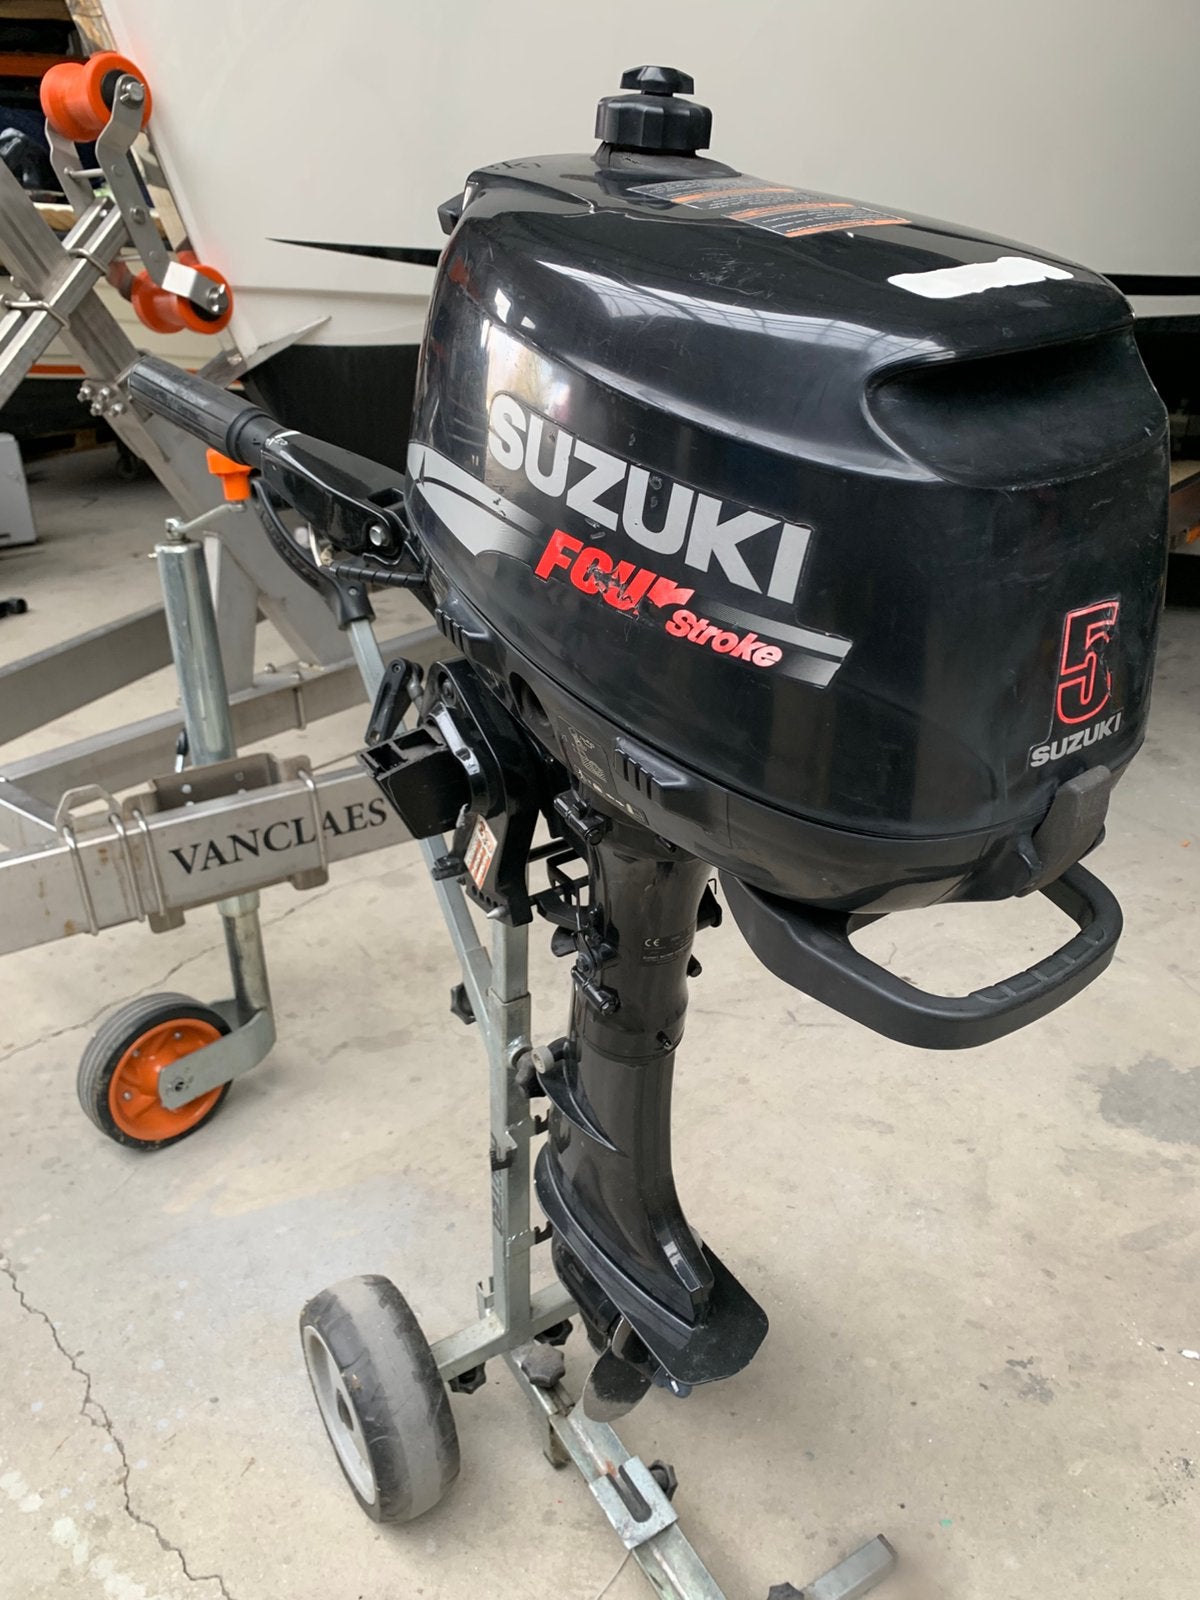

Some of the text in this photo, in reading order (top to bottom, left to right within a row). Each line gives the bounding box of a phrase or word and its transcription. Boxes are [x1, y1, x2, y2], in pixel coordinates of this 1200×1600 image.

[488, 394, 812, 604] SUZUKI
[665, 609, 784, 668] Stroke
[1056, 601, 1120, 724] 5
[1030, 712, 1122, 768] SUZUKI
[169, 798, 388, 875] VANCLAES
